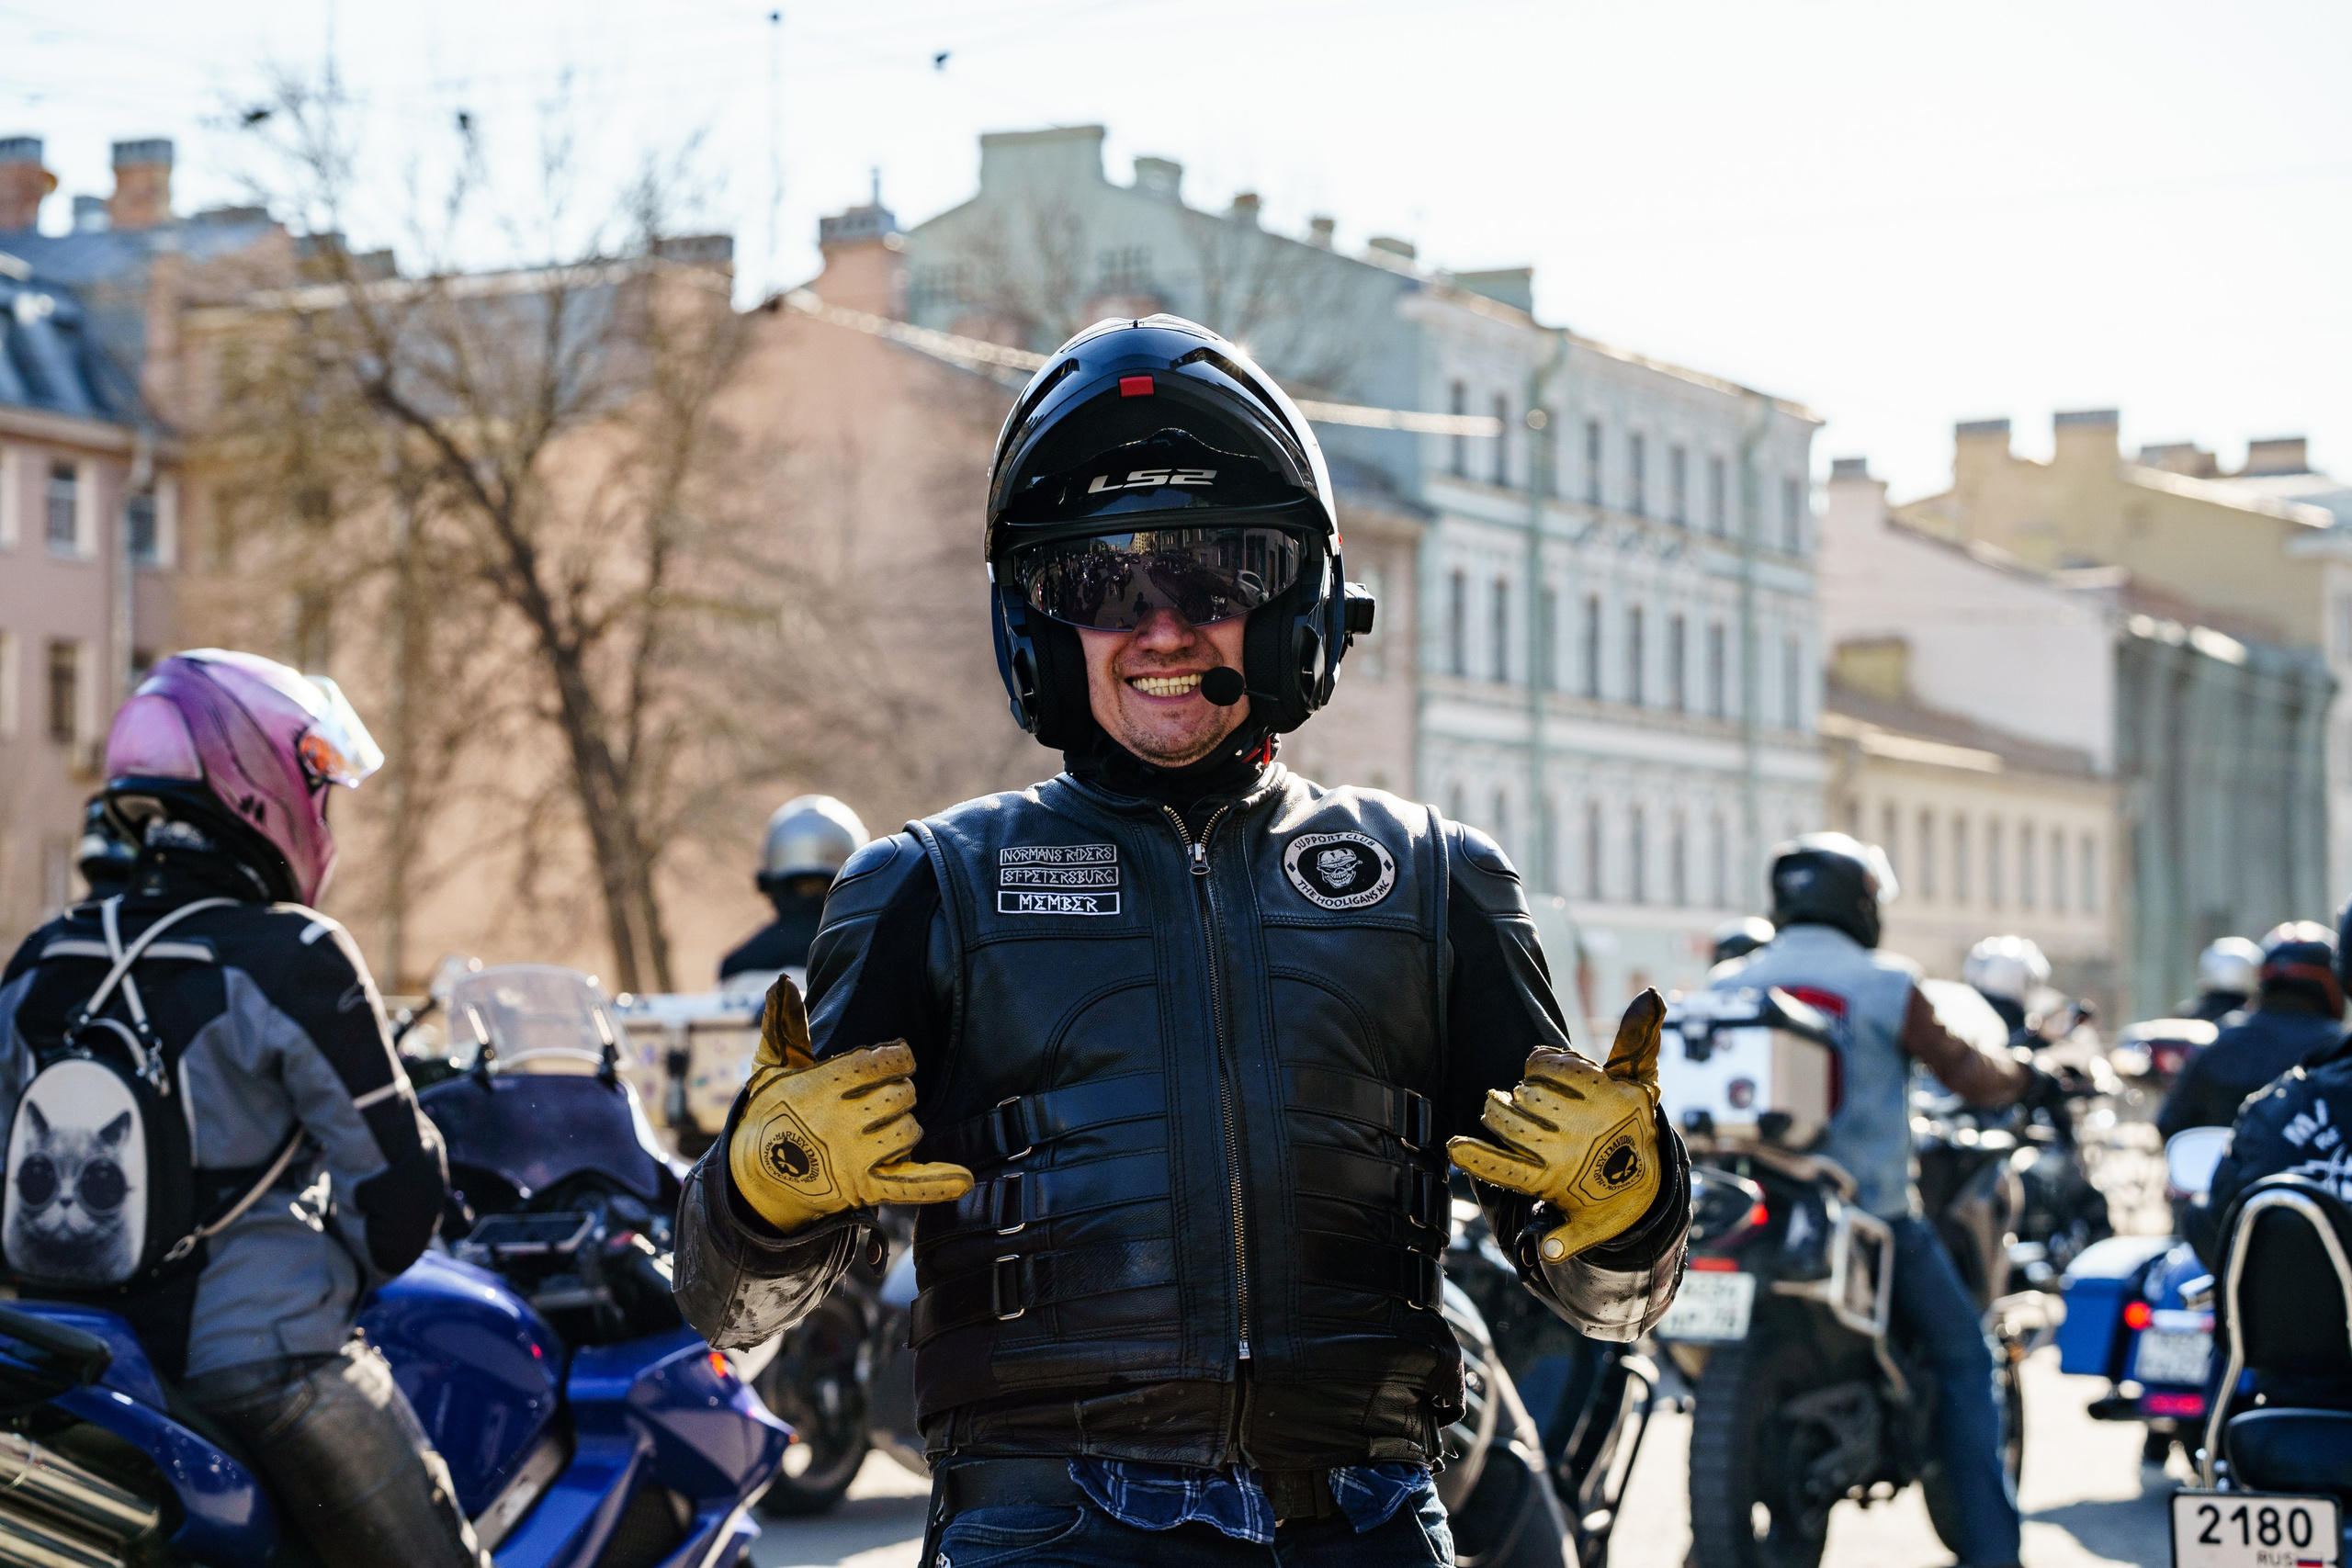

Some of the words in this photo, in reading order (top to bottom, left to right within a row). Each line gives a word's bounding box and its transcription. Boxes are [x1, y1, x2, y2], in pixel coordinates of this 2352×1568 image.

[1088, 468, 1217, 493] LS2
[1295, 833, 1343, 851] SUPPORT
[1346, 833, 1375, 846] CLUB
[1003, 848, 1062, 862] NORMANS
[1065, 846, 1113, 862] RIDERS
[1019, 894, 1099, 912] MEMBER
[1297, 880, 1317, 898] THE
[1317, 890, 1378, 907] HOOLIGANS
[1378, 880, 1390, 896] MC
[2198, 1505, 2312, 1548] 2180
